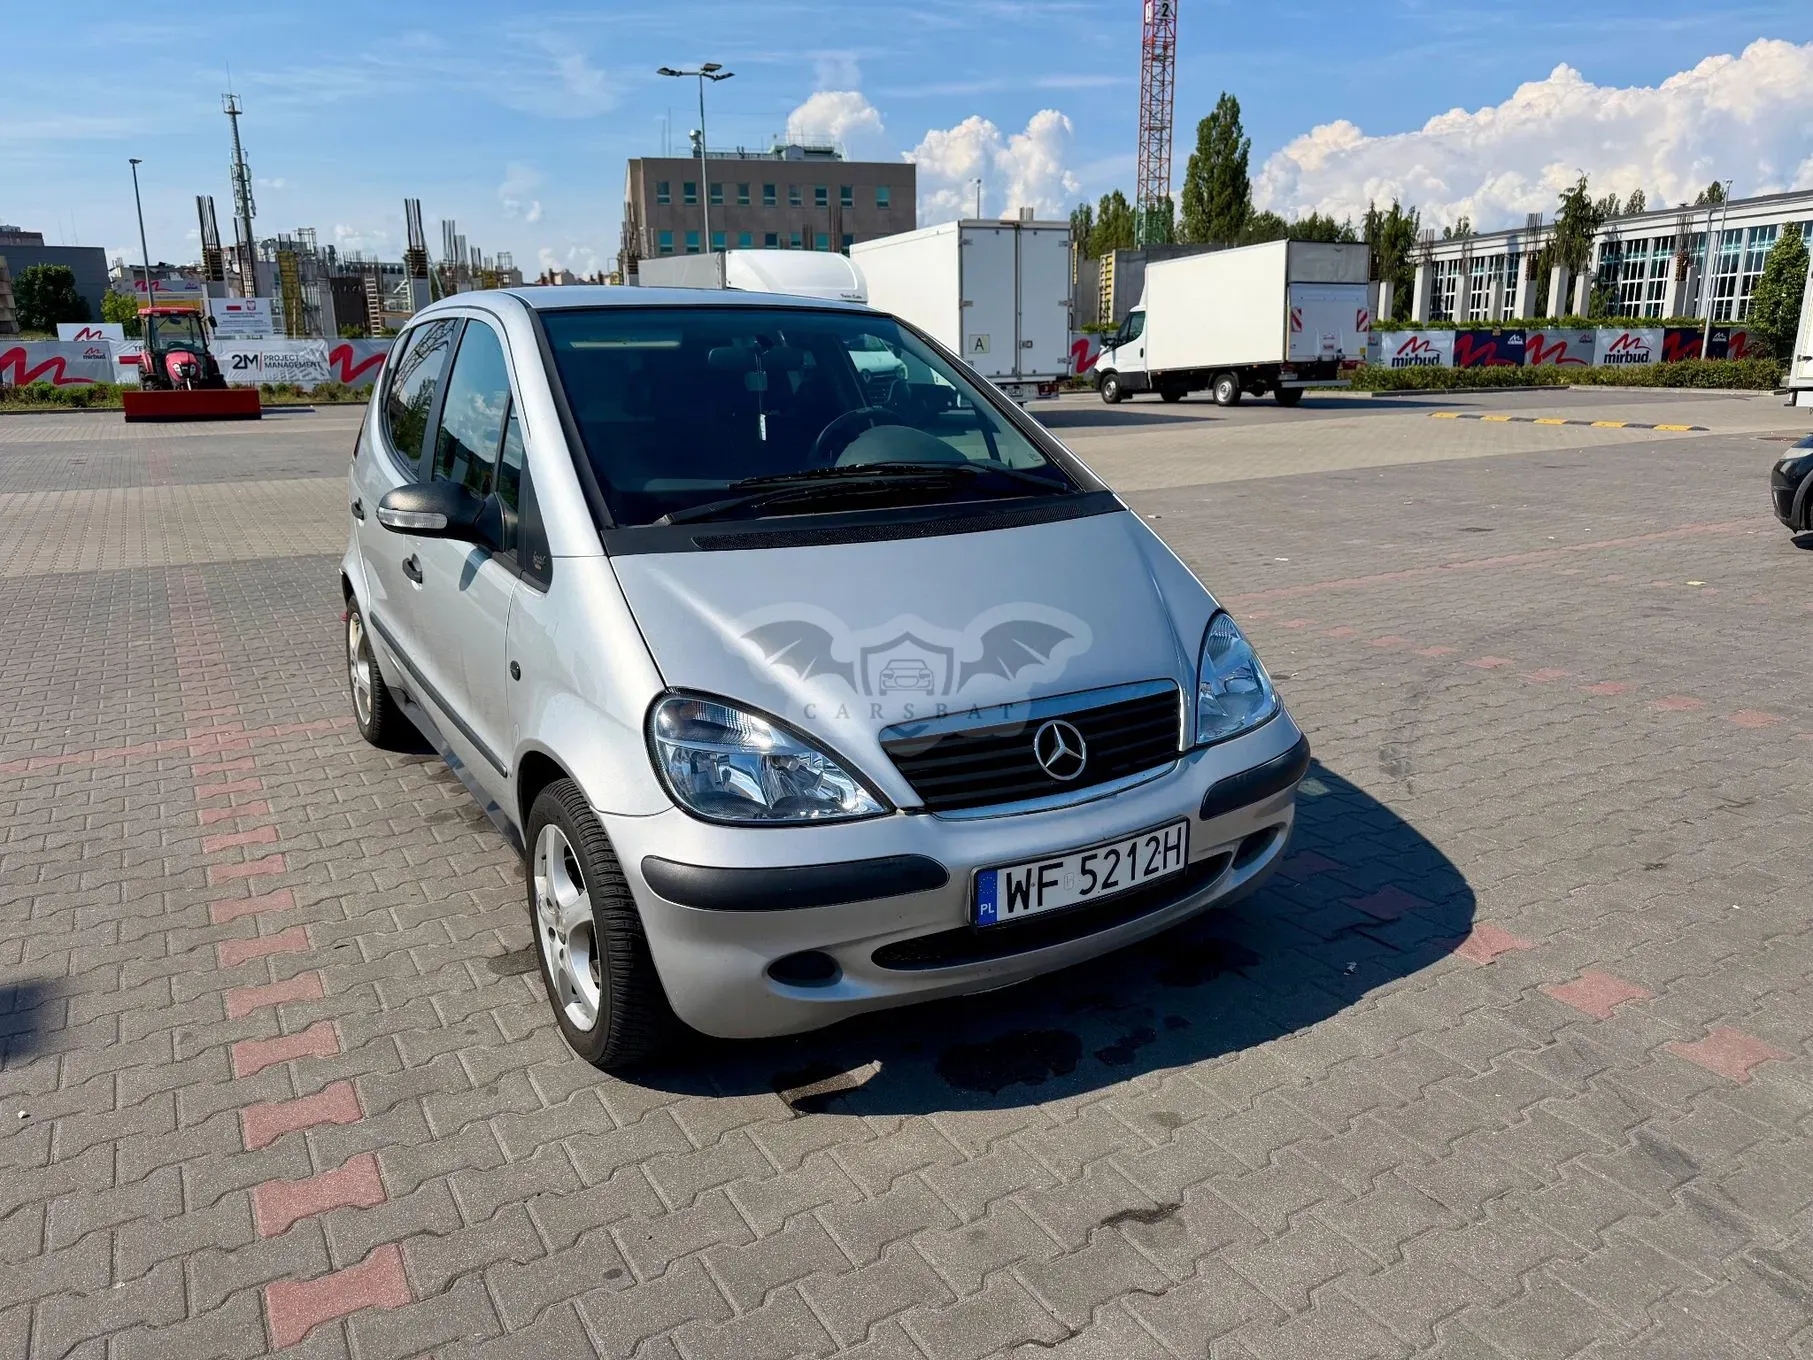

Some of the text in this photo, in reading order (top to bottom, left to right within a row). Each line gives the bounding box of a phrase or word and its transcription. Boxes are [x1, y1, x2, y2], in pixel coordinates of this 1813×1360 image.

[1161, 3, 1169, 17] 2
[975, 337, 984, 351] A
[231, 354, 259, 370] 2M
[264, 354, 299, 362] PROJECT
[1391, 352, 1440, 368] mirbud
[1603, 350, 1649, 364] mirbud
[264, 361, 322, 370] MANAGEMENT
[1005, 826, 1183, 914] WF 5212H
[980, 903, 995, 916] PL
